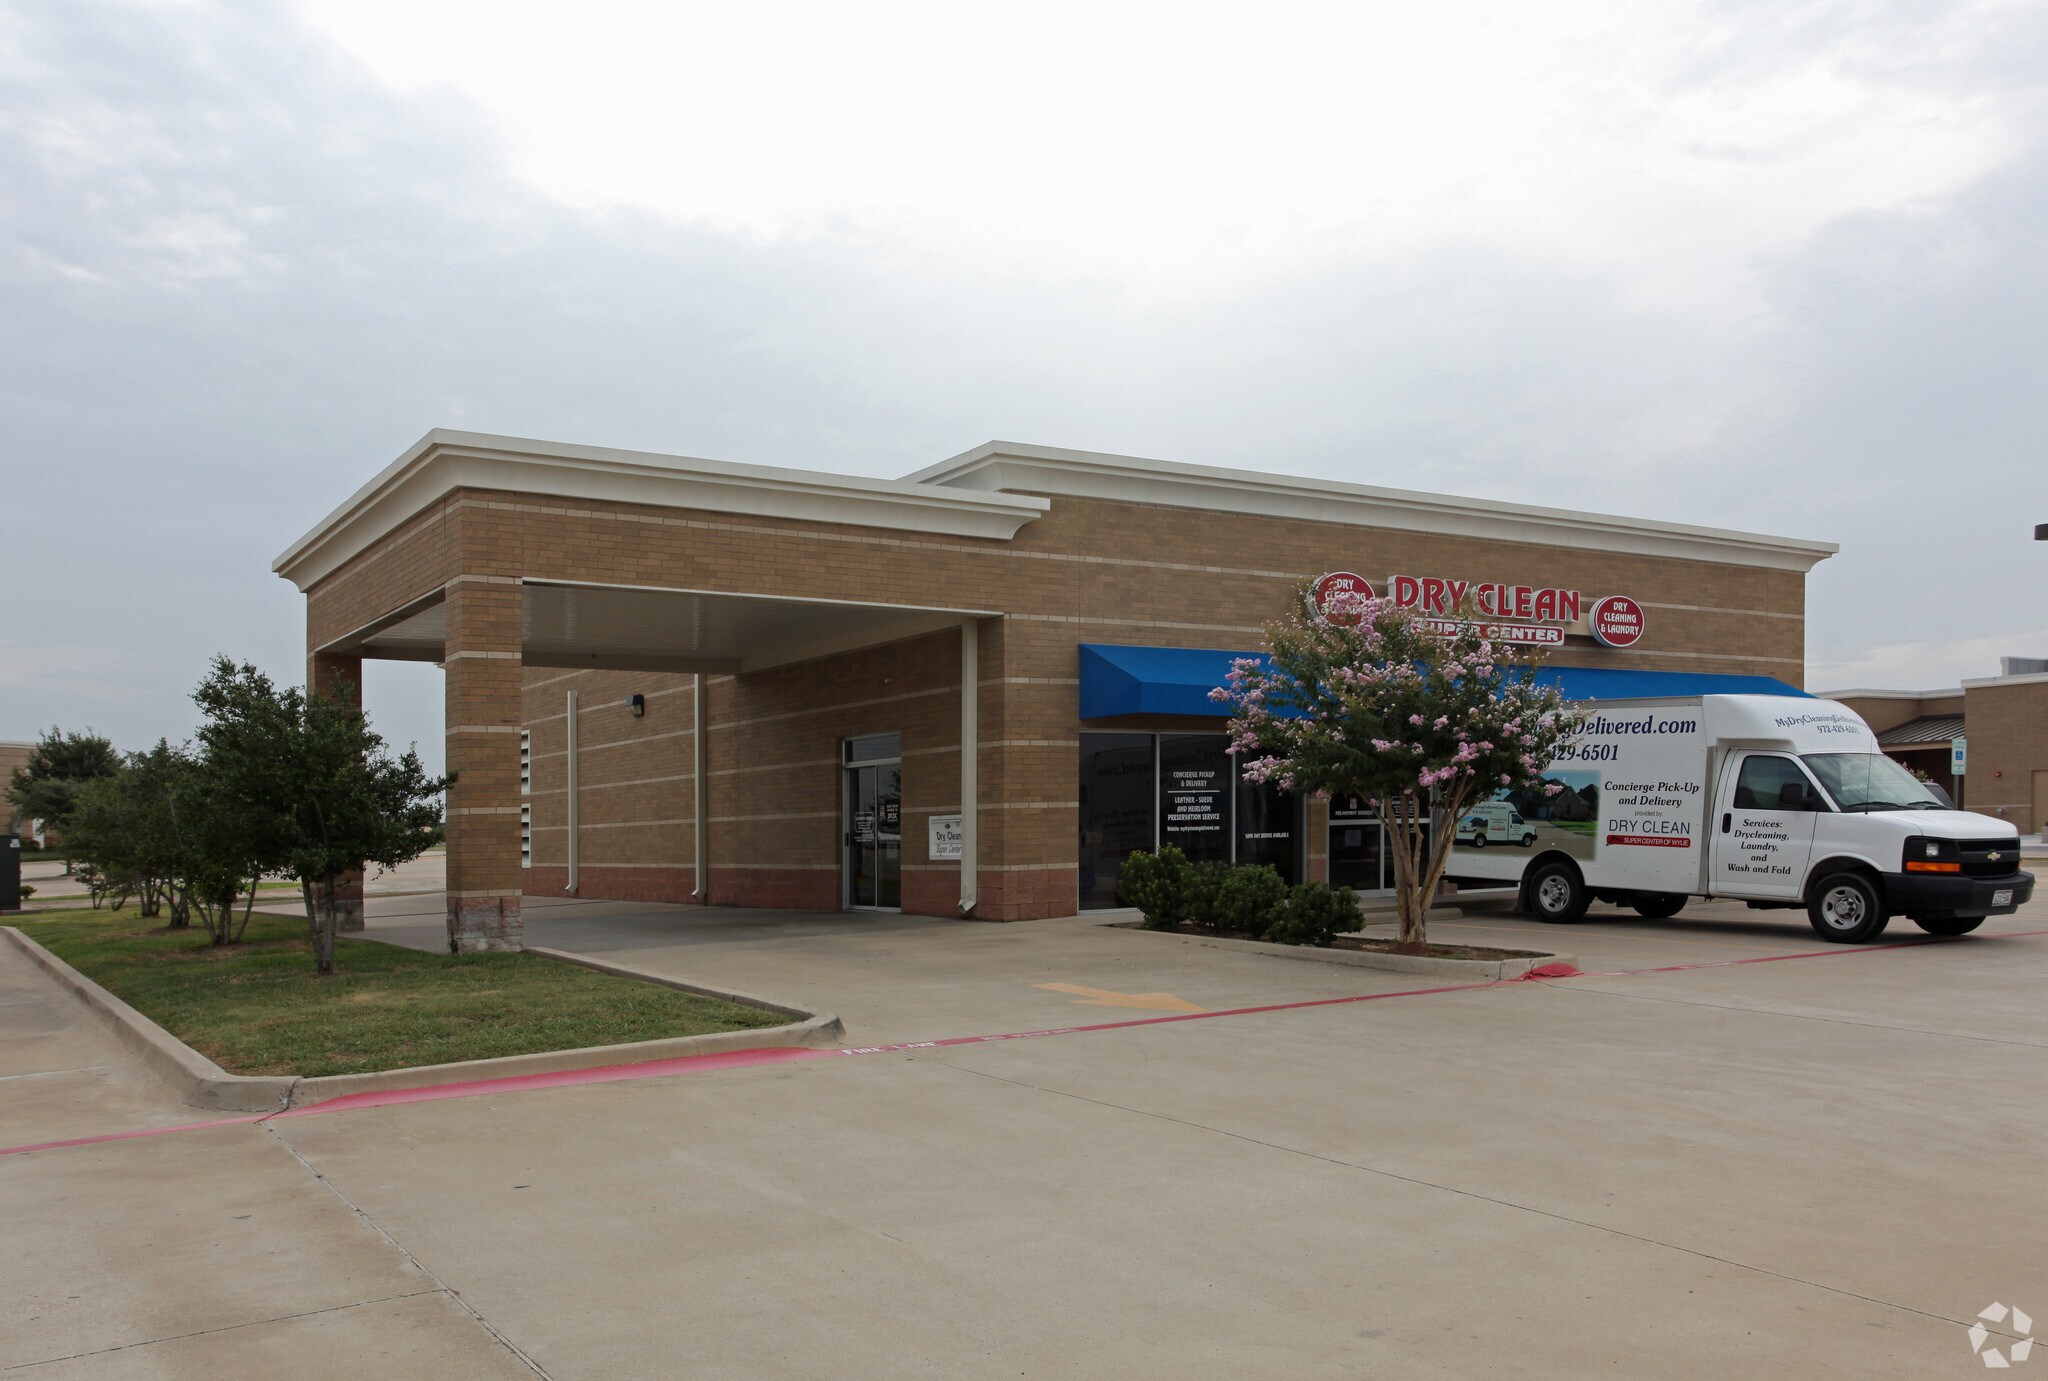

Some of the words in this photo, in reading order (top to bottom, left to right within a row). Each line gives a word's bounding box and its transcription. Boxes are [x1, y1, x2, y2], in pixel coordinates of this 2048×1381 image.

[1335, 578, 1354, 590] DRY
[1324, 590, 1366, 603] CLENG
[1392, 575, 1469, 616] DRY
[1477, 583, 1580, 623] CLEAN
[1613, 601, 1628, 612] DRY
[1603, 612, 1637, 623] CLEANING
[1415, 621, 1481, 638] UPER
[1486, 626, 1559, 641] CENTER
[1600, 623, 1606, 633] &
[1607, 624, 1639, 636] LAUNDRY
[1173, 771, 1198, 779] CONCIERGE
[1604, 781, 1655, 794] Concierge
[1657, 781, 1699, 794] Pick-Up
[1174, 796, 1195, 804] LEATHER
[1618, 795, 1637, 805] and
[1640, 796, 1682, 808] Delivery
[1168, 813, 1201, 821] PRESERVATION
[1742, 818, 1783, 828] Services:
[1609, 819, 1638, 832] DRY
[1642, 820, 1690, 834] CLEAN
[936, 831, 945, 842] Dry
[1734, 829, 1789, 841] Drycleaning,
[1672, 839, 1689, 847] WYLIE
[1740, 841, 1779, 853] Laundry,
[1750, 854, 1768, 862] and
[1728, 863, 1750, 873] Wash
[1752, 865, 1769, 873] and
[1771, 865, 1792, 875] Fold
